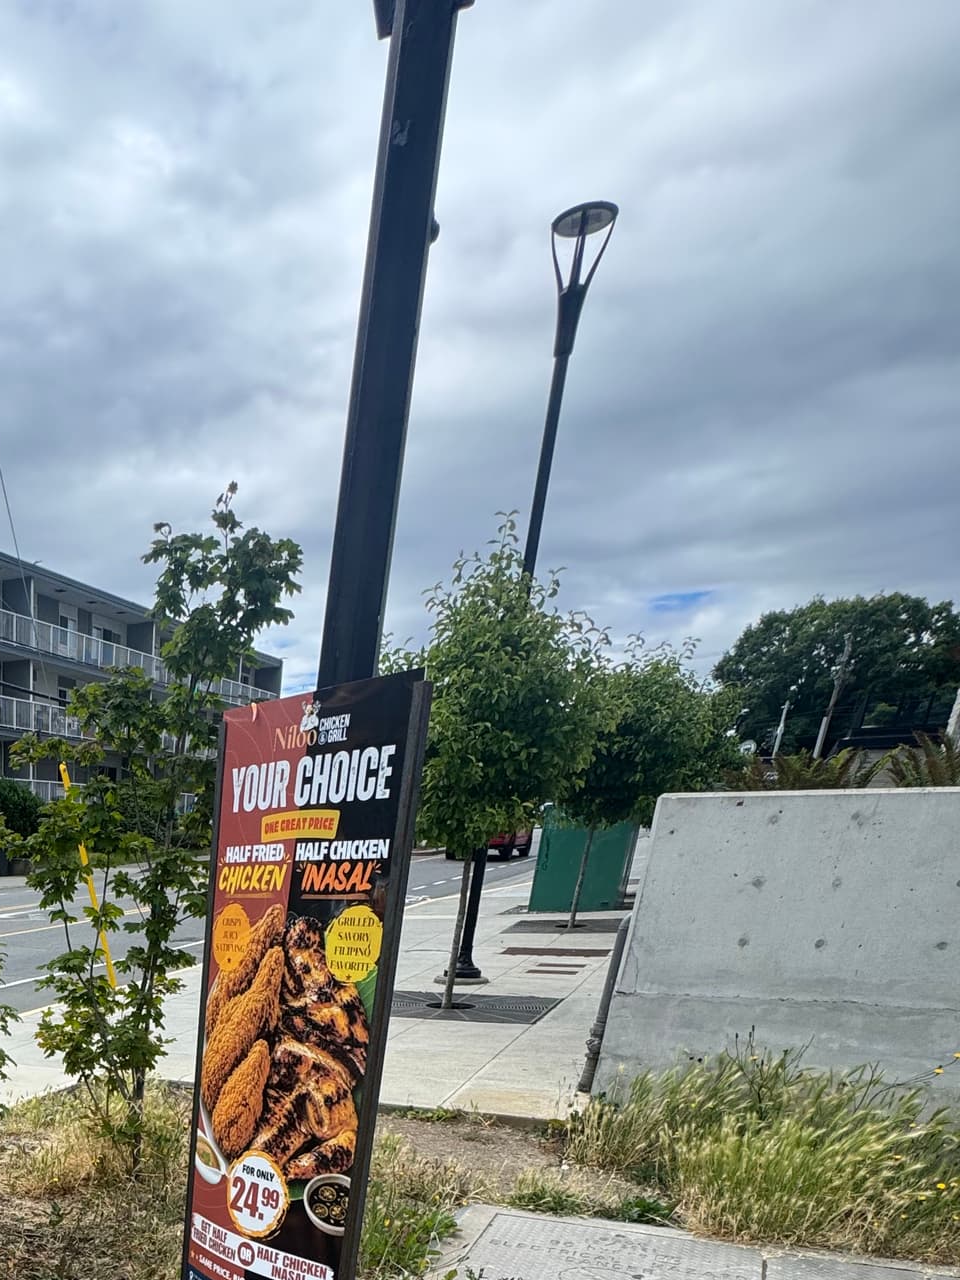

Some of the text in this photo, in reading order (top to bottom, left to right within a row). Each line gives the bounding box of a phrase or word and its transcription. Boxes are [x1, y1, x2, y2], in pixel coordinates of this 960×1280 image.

[319, 713, 351, 731] CHICKEN
[273, 725, 317, 752] Niloo
[327, 728, 348, 743] GRILL
[232, 744, 396, 813] YOUR CHOICE
[264, 816, 335, 835] ONE GREAT PRICE
[225, 843, 285, 864] HALF FRIED
[295, 838, 391, 862] HALF CHICKEN
[218, 863, 288, 894] CHICKEN
[300, 861, 372, 892] INASAL
[337, 916, 375, 928] GRILLED
[337, 931, 370, 942] SAVORY
[334, 945, 371, 957] FILIPINO
[241, 1164, 276, 1182] FOR ONLY
[229, 1175, 280, 1221] 24.99
[200, 1219, 228, 1244] GET HALF
[193, 1227, 236, 1262] FRIED CHICKEN
[239, 1247, 252, 1263] OR
[198, 1254, 213, 1271] SAME
[256, 1246, 328, 1280] HALF CHICKEN
